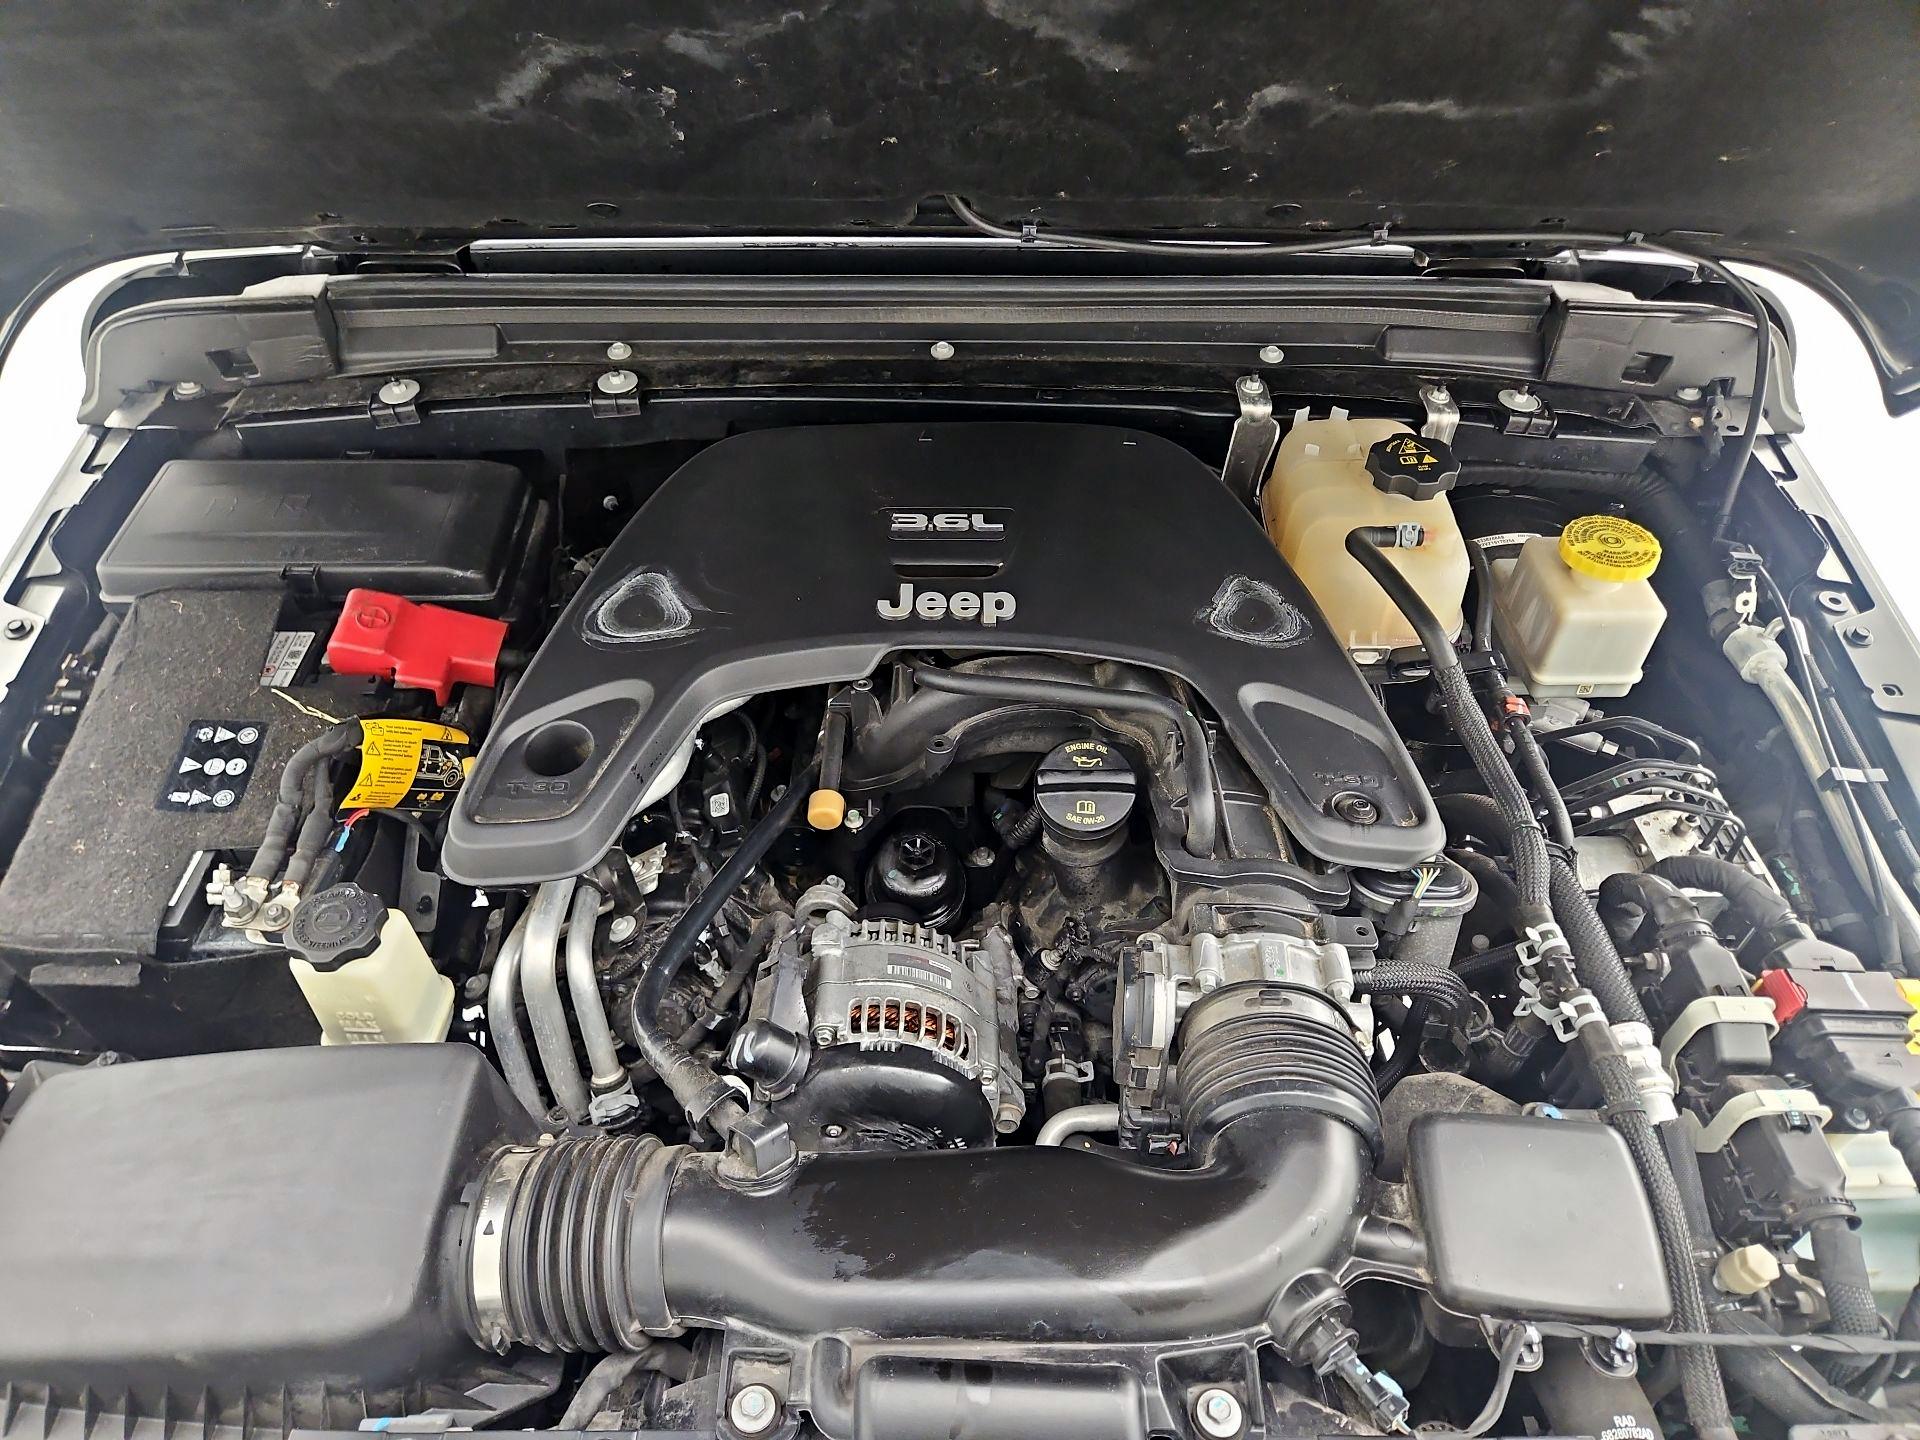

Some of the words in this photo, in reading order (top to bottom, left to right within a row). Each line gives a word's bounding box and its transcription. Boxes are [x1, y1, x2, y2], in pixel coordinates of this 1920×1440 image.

[891, 513, 1004, 532] 3.6L
[877, 583, 1016, 627] Jeep
[1064, 742, 1095, 753] ENGINE
[1096, 744, 1108, 755] OIL
[1066, 813, 1082, 824] SAE
[1083, 814, 1105, 825] 0W-20
[1613, 1415, 1636, 1428] RAD
